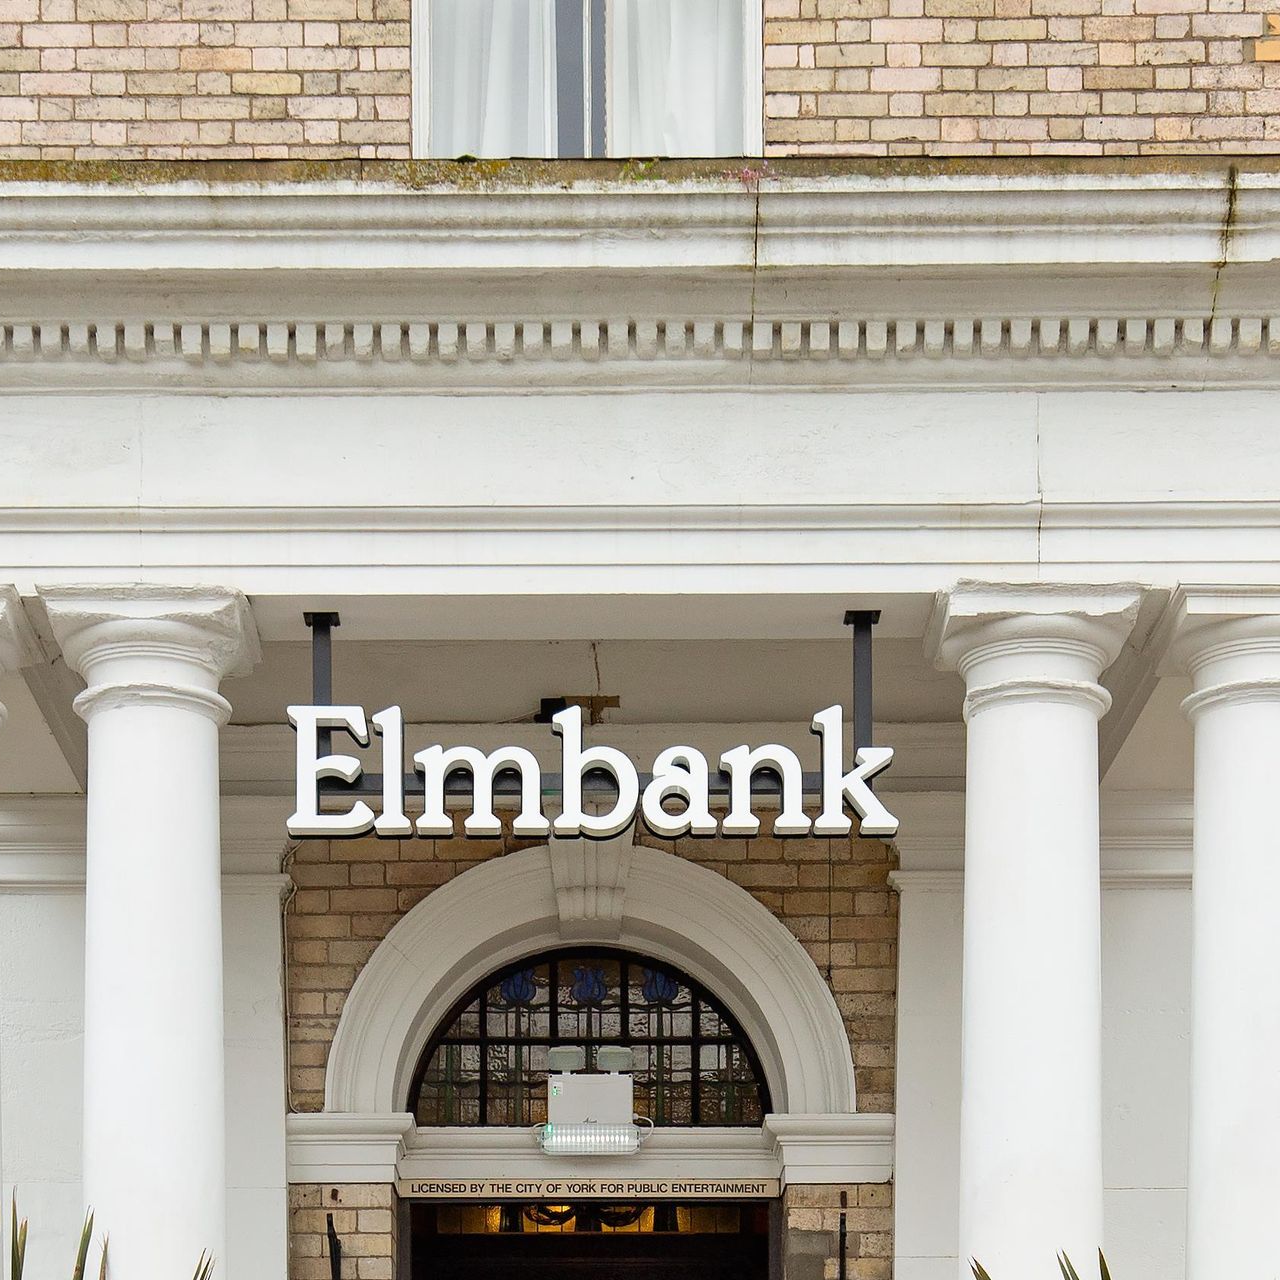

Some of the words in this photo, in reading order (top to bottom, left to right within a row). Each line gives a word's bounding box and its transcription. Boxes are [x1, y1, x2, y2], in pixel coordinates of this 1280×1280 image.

[286, 704, 900, 836] Elmbank
[411, 1183, 466, 1193] LICENSED
[470, 1183, 485, 1193] BY
[489, 1183, 512, 1193] THE
[516, 1183, 542, 1193] CITY
[546, 1183, 561, 1193] OF
[566, 1183, 596, 1193] YORK
[600, 1183, 624, 1193] FOR
[627, 1183, 668, 1193] PUBLIC
[671, 1183, 767, 1193] ENTERTAINMENT
